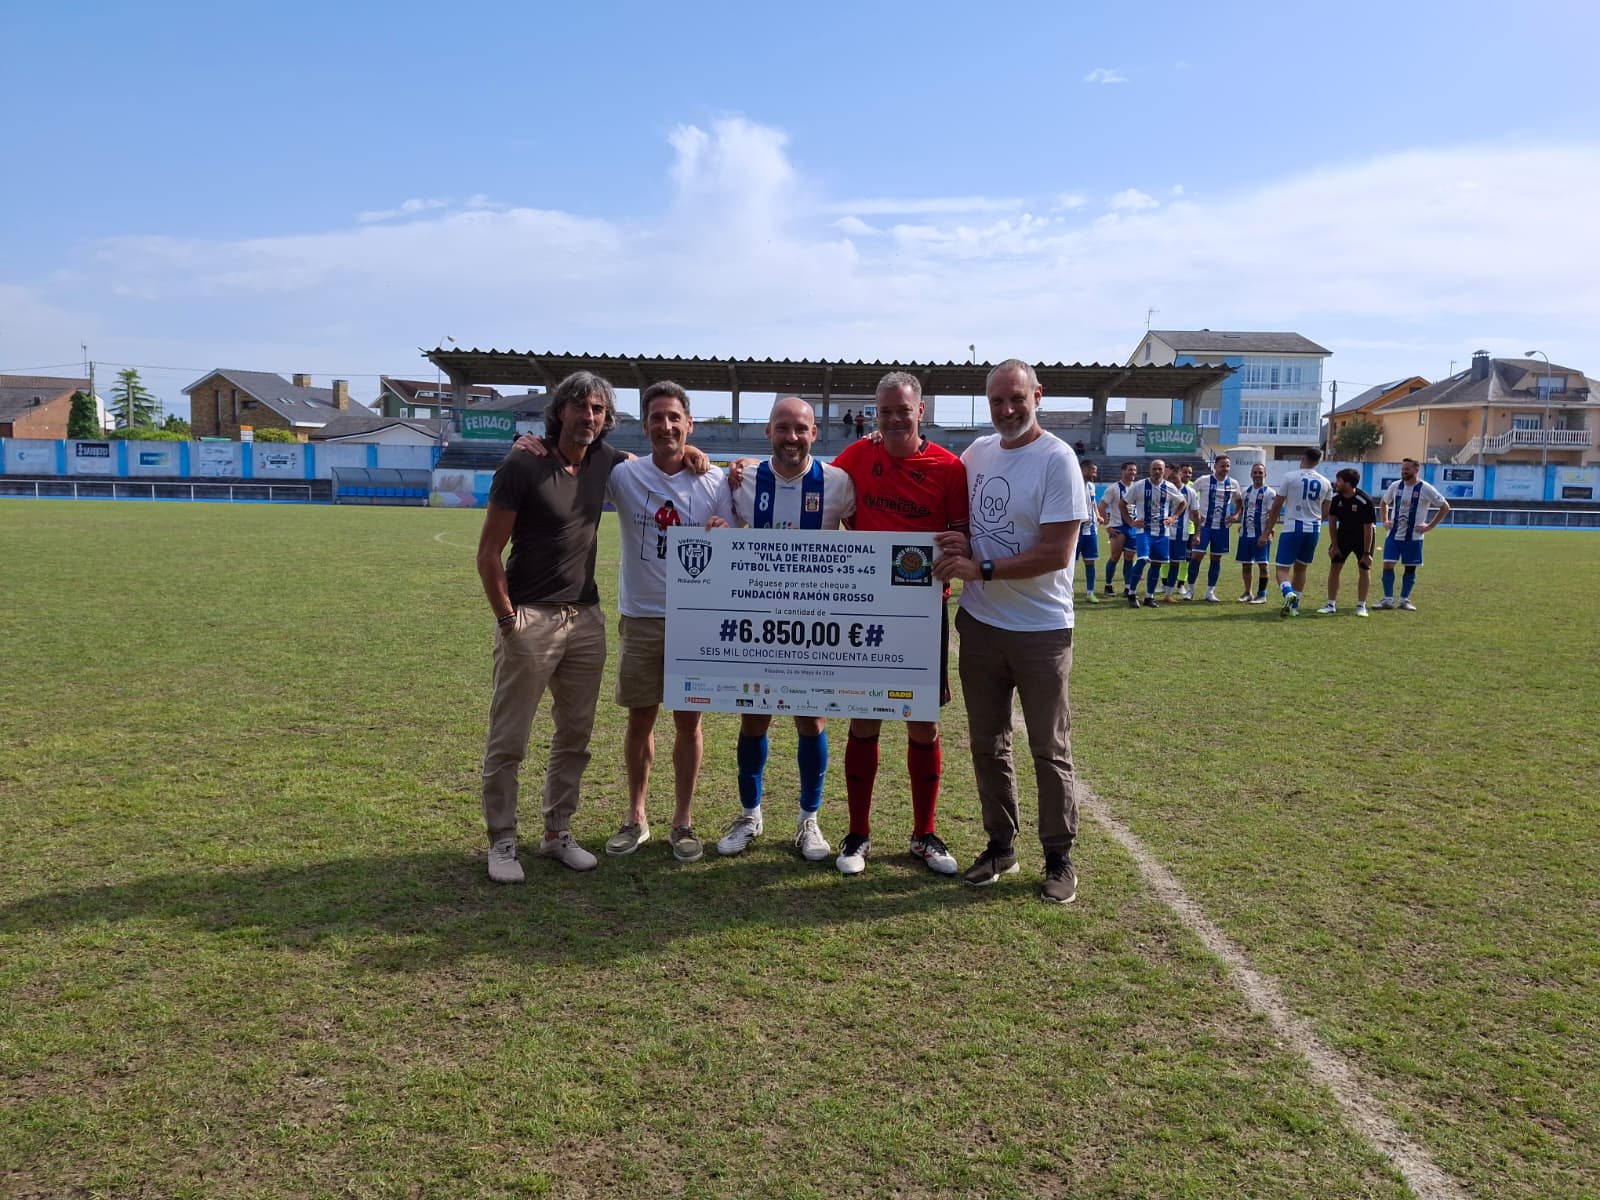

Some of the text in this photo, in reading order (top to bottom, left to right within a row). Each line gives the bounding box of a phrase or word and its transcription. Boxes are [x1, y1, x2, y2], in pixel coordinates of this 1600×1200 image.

[464, 415, 511, 431] FEIRACO
[1148, 429, 1194, 445] FEIRACO
[1301, 478, 1322, 500] 19
[759, 492, 770, 511] 8
[731, 541, 876, 554] XX TORNEO INTERNACIONAL
[754, 551, 852, 563] "VILA DE RIBADEO"
[731, 559, 876, 575] FÚTBOL VETERANOS +35 +45
[748, 579, 783, 589] Páguese
[784, 581, 798, 589] por
[800, 580, 818, 588] este
[820, 580, 849, 591] cheque
[731, 588, 874, 602] FUNDACIÓN RAMÓN GROSSO
[783, 608, 815, 616] cantidad
[720, 618, 885, 649] #6.850,00 €#
[700, 646, 904, 663] SEIS MIL OCHOCIENTOS CINCUENTA EUROS
